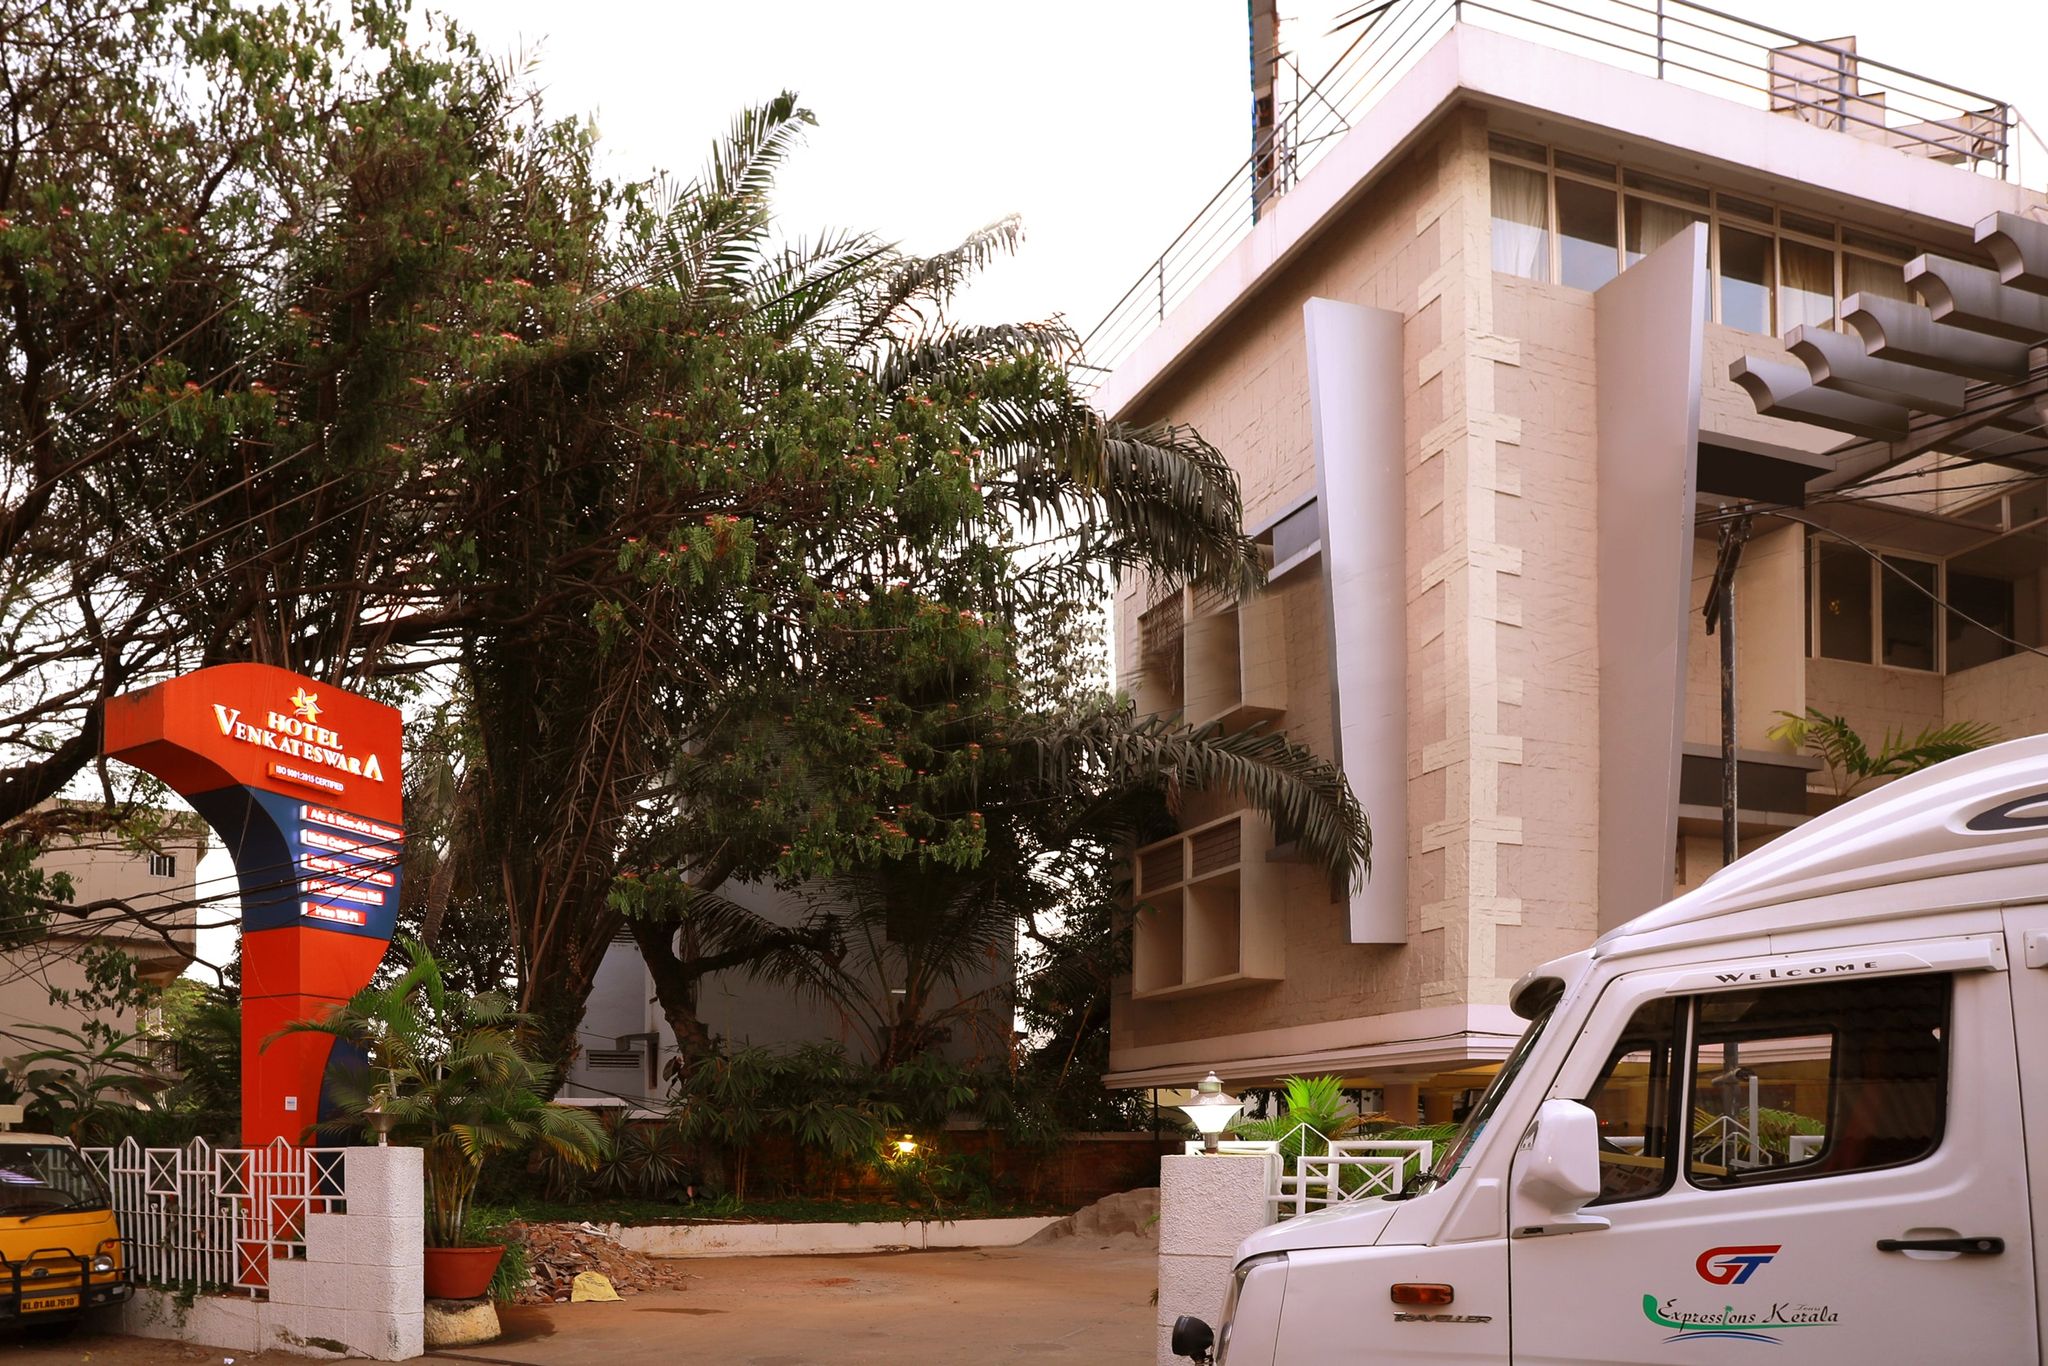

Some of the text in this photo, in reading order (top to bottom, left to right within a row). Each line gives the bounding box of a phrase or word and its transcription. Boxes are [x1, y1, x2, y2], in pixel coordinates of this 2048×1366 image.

[212, 704, 384, 782] VENKATESWARA
[267, 711, 343, 750] HOTEL
[276, 765, 287, 775] ISO
[315, 776, 344, 791] CERTIFIED
[327, 813, 336, 824] &
[1695, 1244, 1782, 1285] GT
[1657, 1298, 1839, 1333] Expressions Kerala
